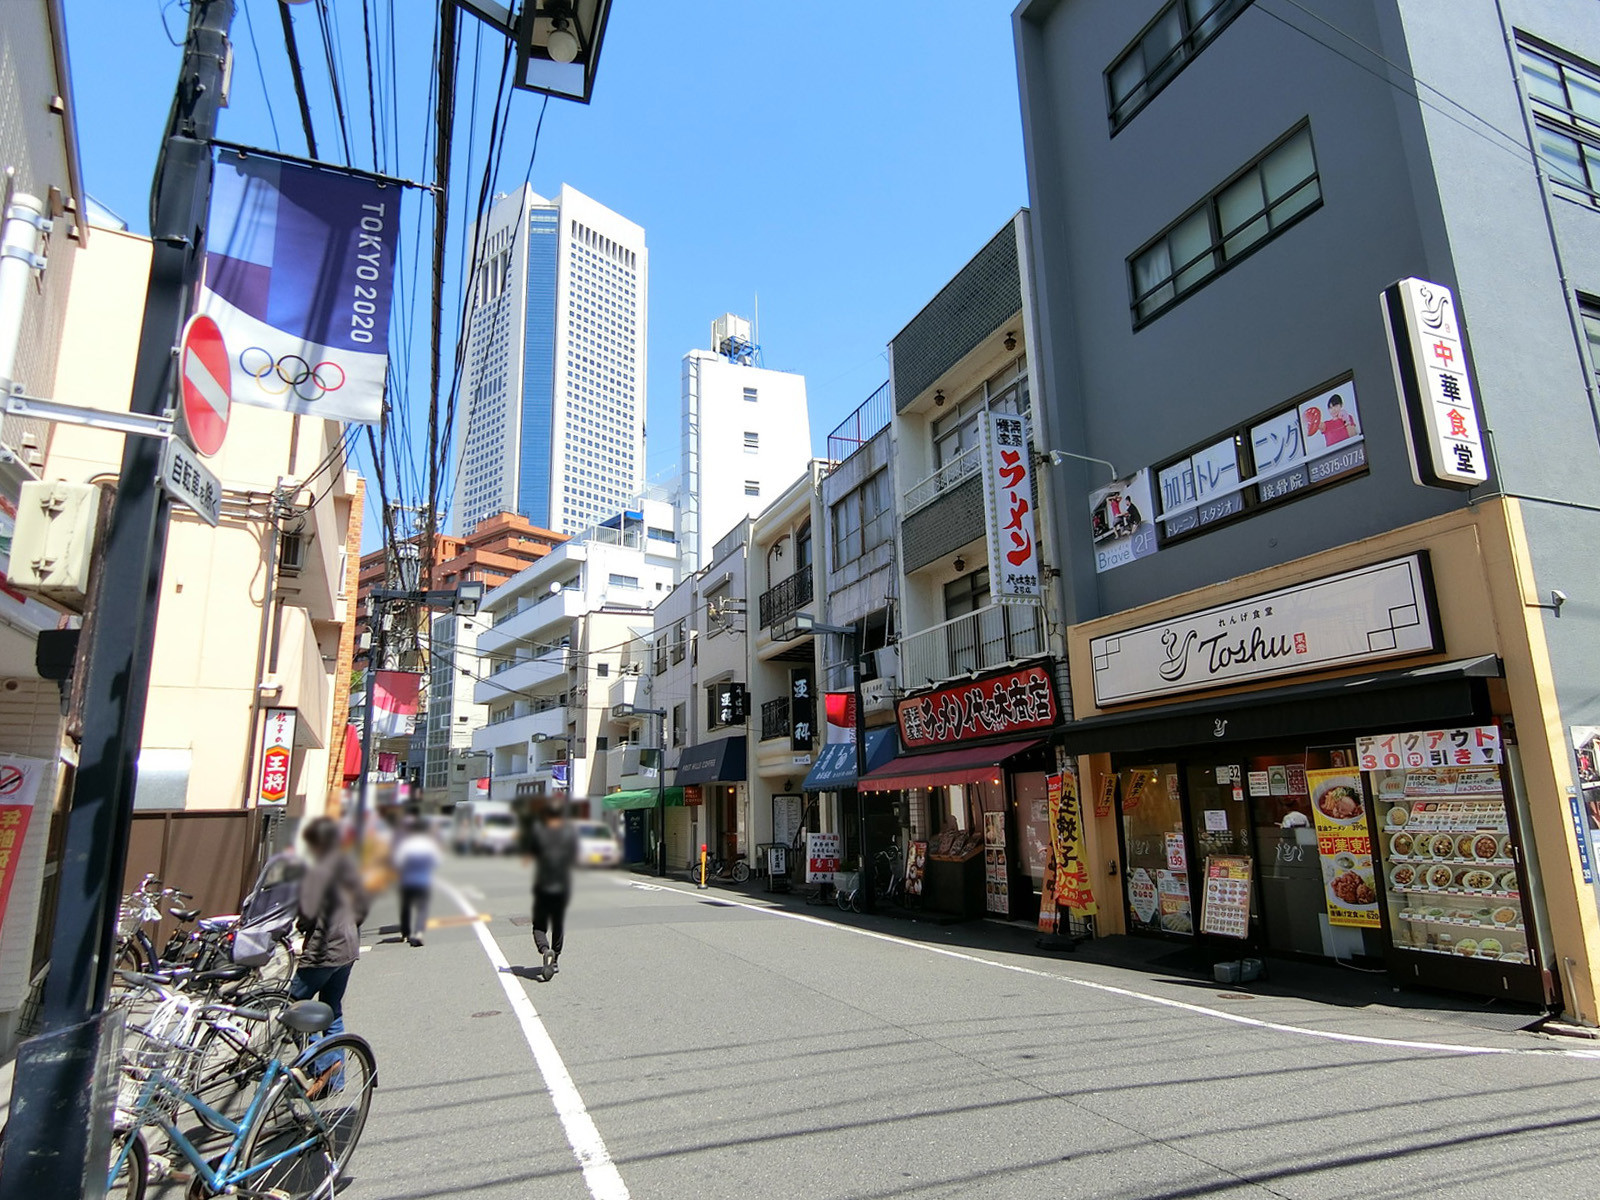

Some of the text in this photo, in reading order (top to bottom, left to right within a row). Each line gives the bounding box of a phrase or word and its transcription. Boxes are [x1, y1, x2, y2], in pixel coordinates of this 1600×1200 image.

[350, 203, 385, 344] TOKYO 2020
[1433, 340, 1477, 475] 中華食堂
[172, 453, 217, 517] 自転車を除く
[1263, 473, 1303, 500] 接骨院
[999, 450, 1032, 567] ラーメン
[1098, 547, 1131, 570] Brave
[1134, 530, 1154, 553] 2F
[1218, 606, 1273, 627] れんげ食堂
[1198, 626, 1292, 674] Toshu
[1359, 727, 1495, 754] テイクアウト
[264, 756, 286, 791] 王将
[1229, 765, 1240, 778] 32
[1056, 789, 1078, 868] 生餃子
